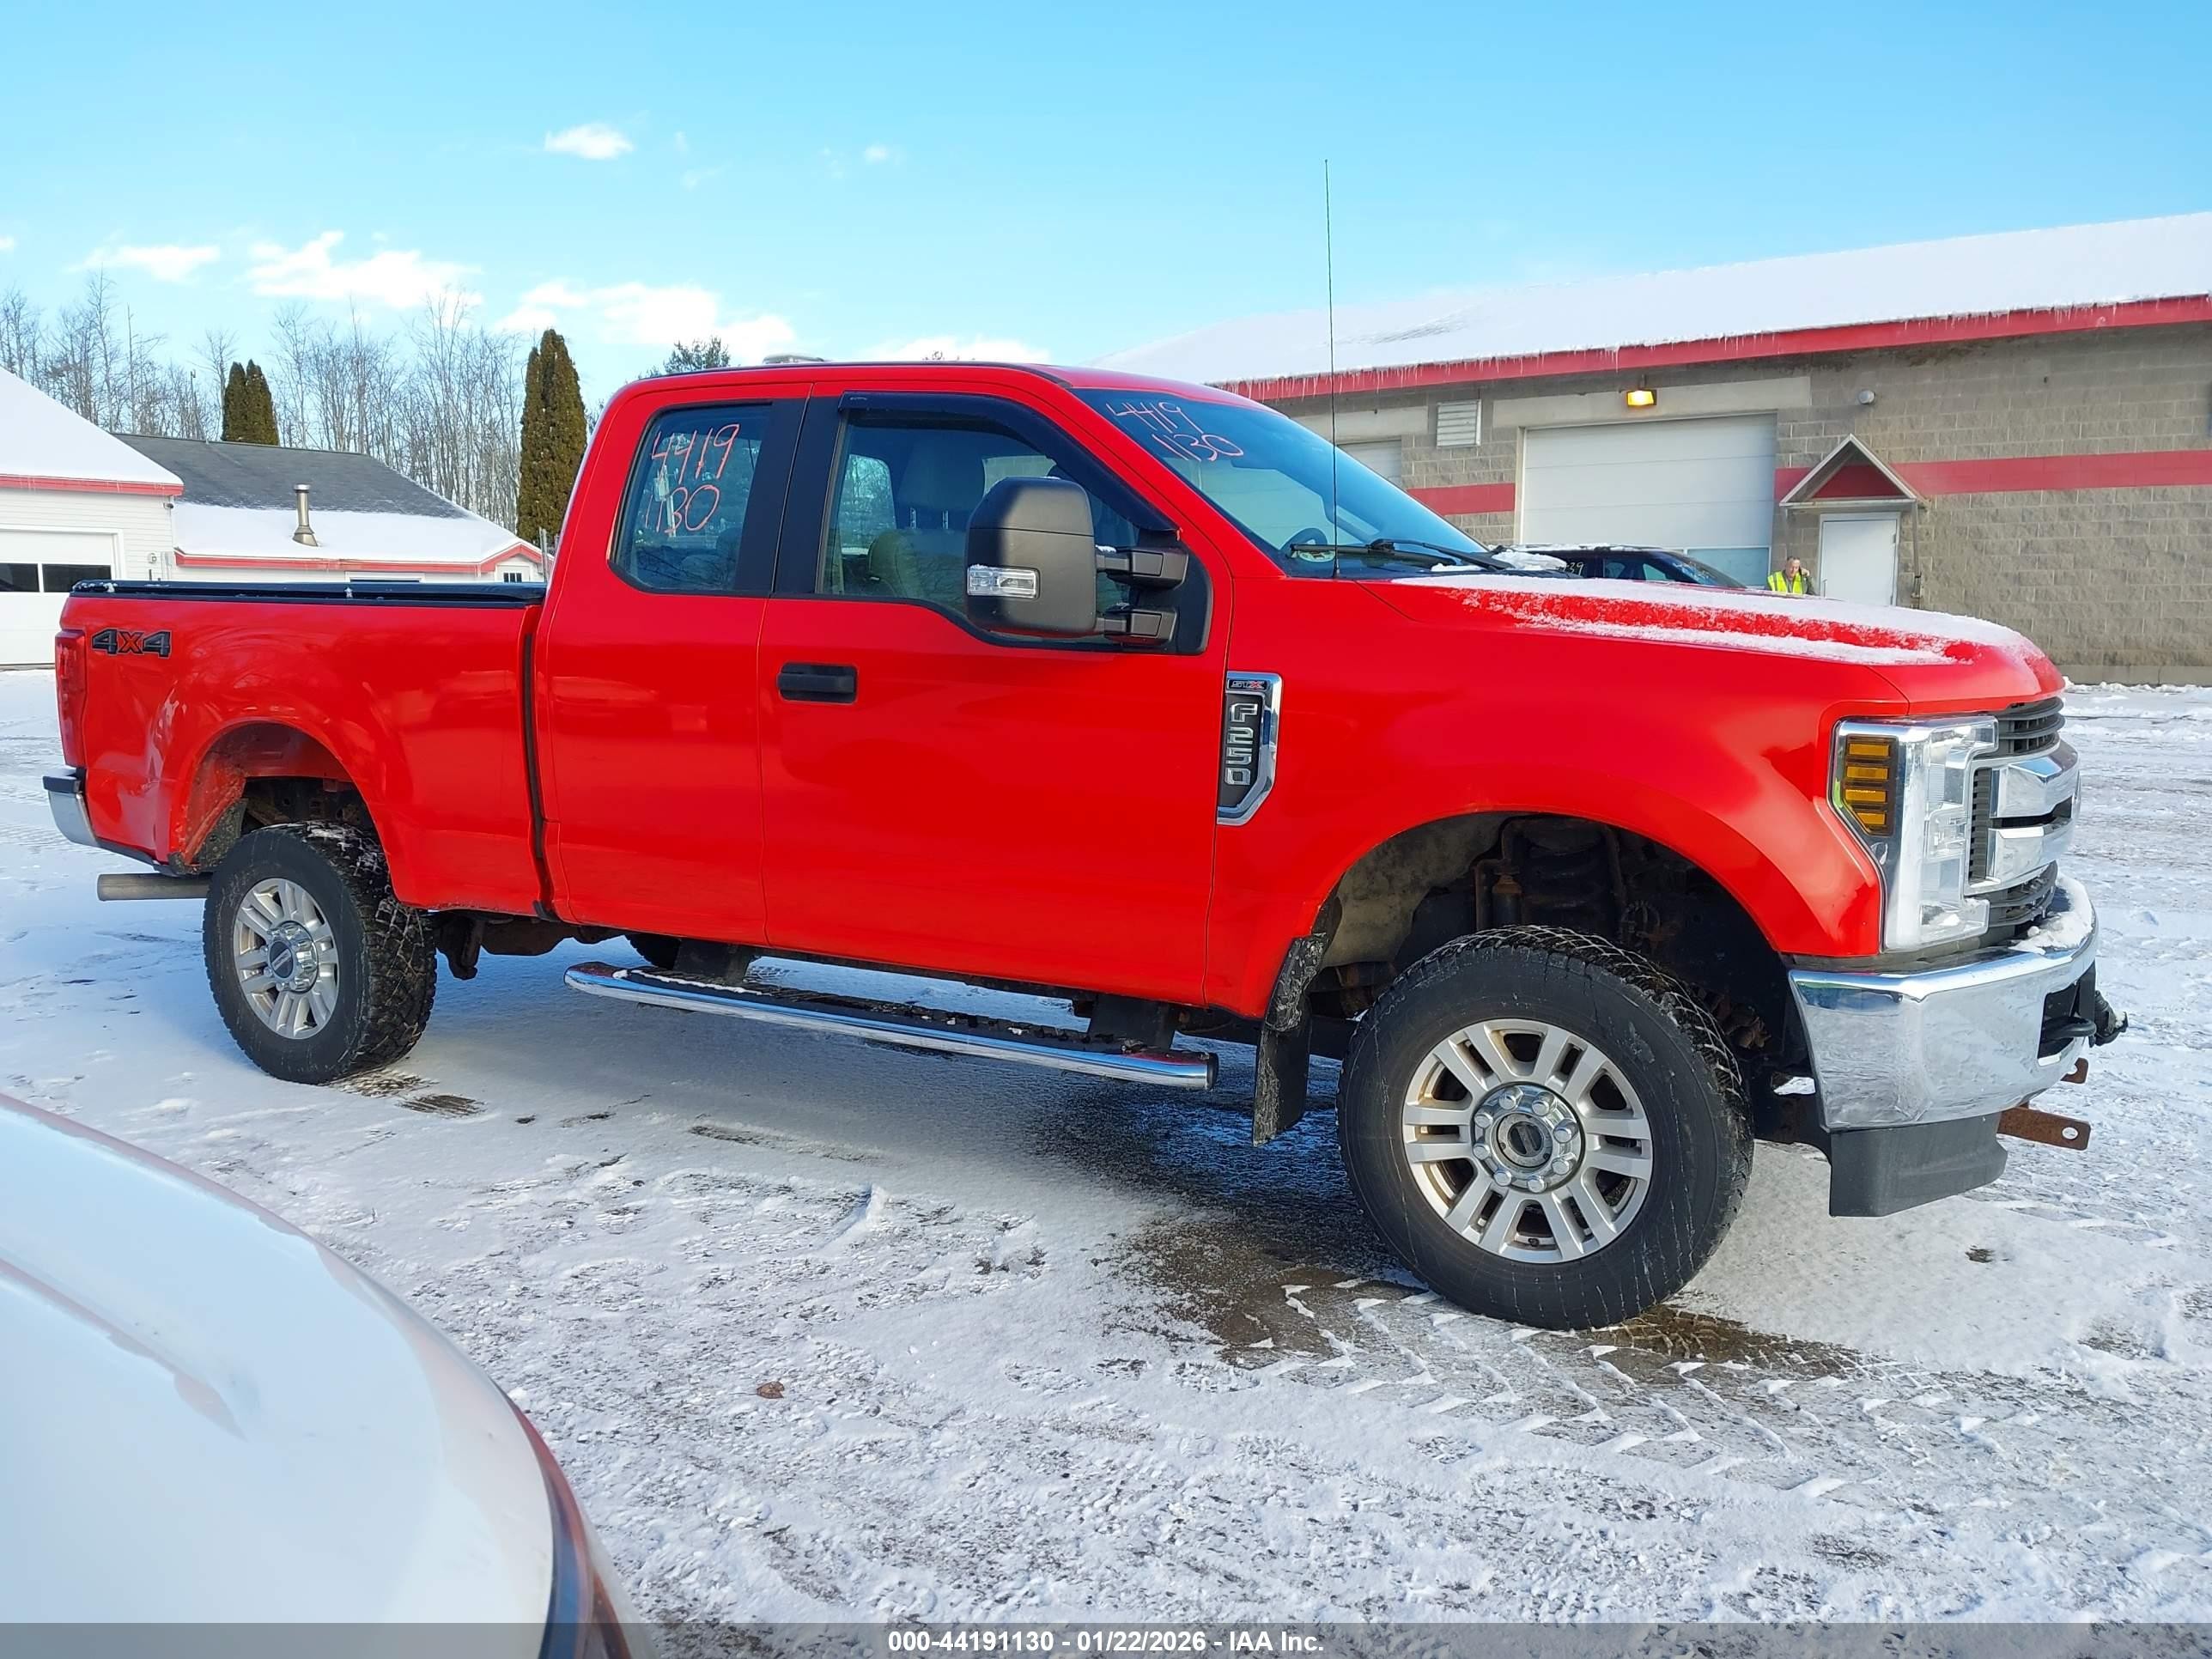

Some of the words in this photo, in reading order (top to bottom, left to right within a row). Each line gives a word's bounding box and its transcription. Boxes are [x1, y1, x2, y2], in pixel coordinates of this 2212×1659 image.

[1105, 401, 1204, 434] 4419
[650, 423, 739, 484] 4419
[1152, 433, 1244, 462] 1130
[645, 484, 720, 533] 1130
[1224, 702, 1259, 786] F250
